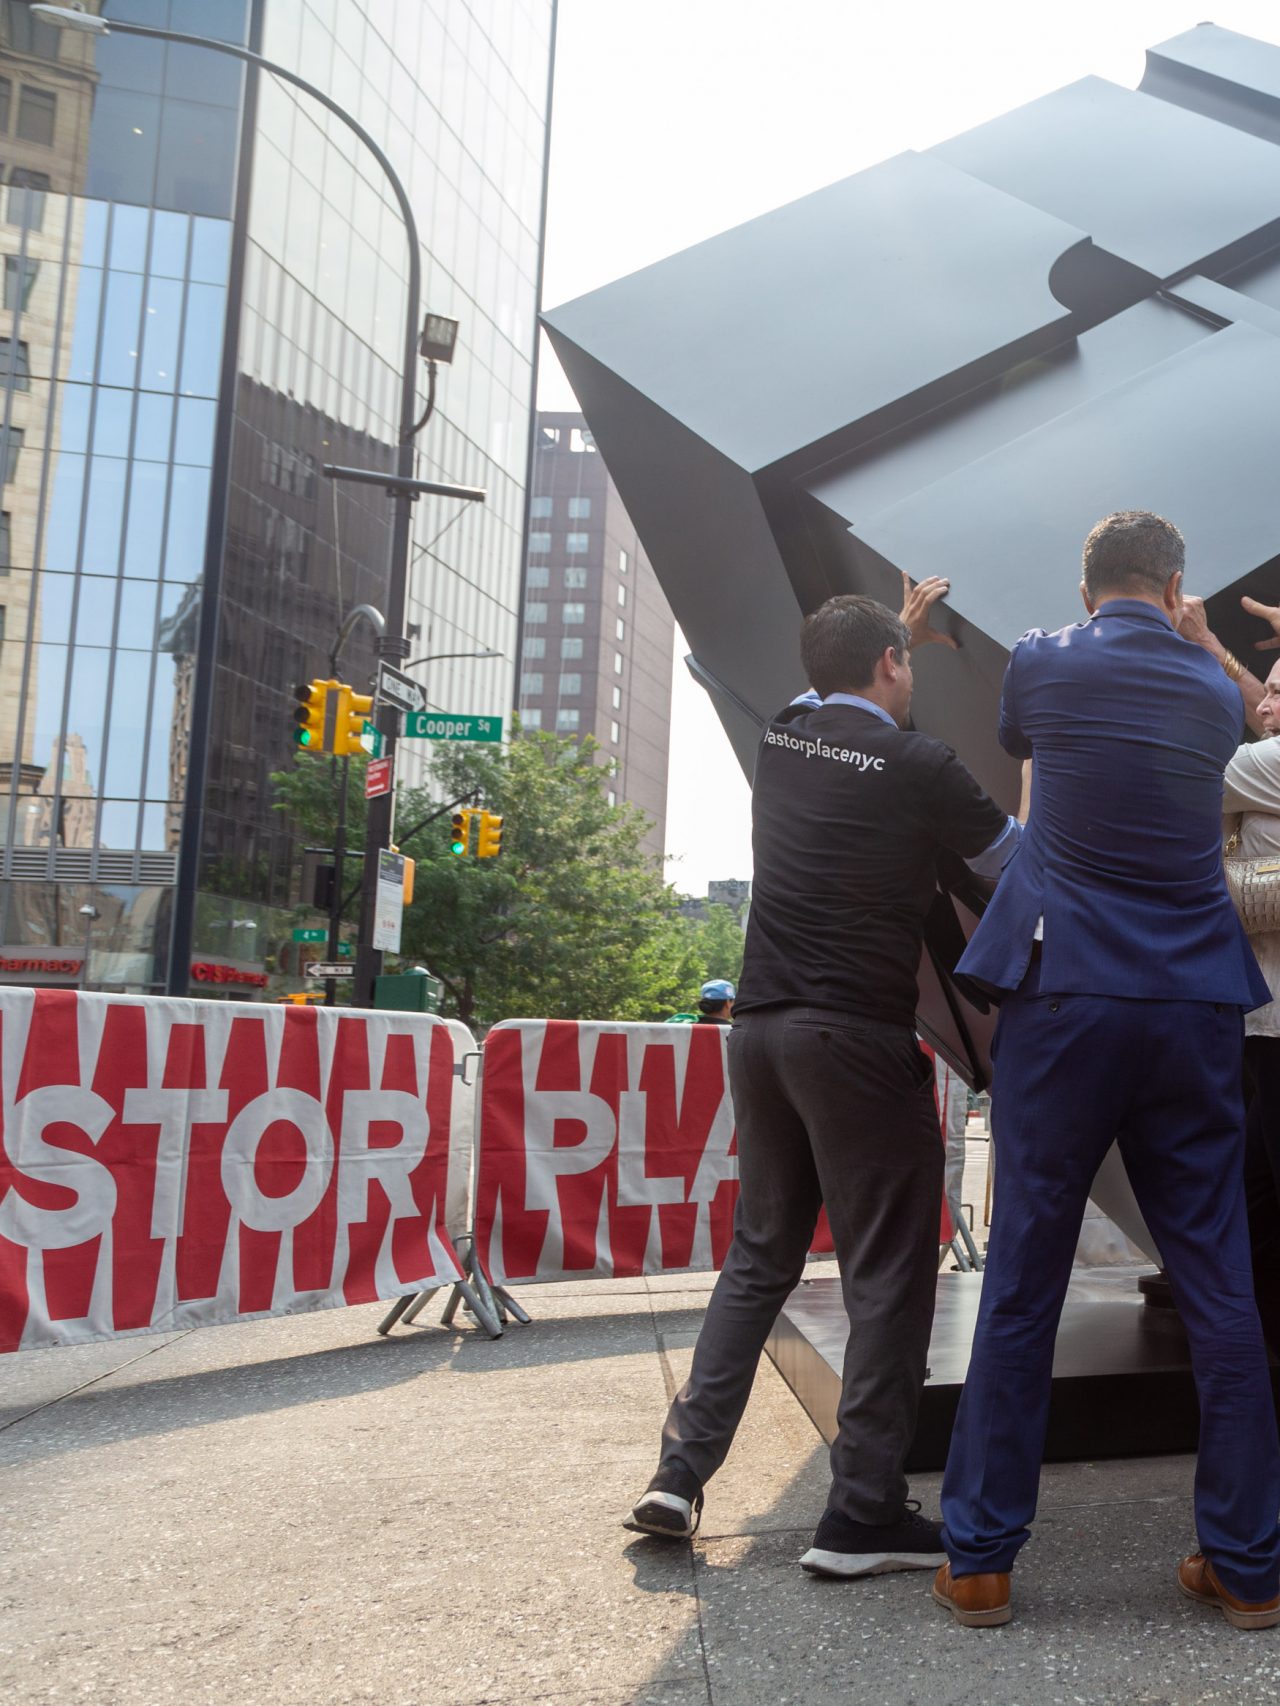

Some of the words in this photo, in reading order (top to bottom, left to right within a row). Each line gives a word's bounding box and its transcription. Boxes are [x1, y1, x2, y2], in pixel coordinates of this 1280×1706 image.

[385, 676, 402, 698] ONE
[415, 716, 472, 740] Cooper
[477, 719, 491, 734] Sq
[0, 1084, 430, 1250] STOR
